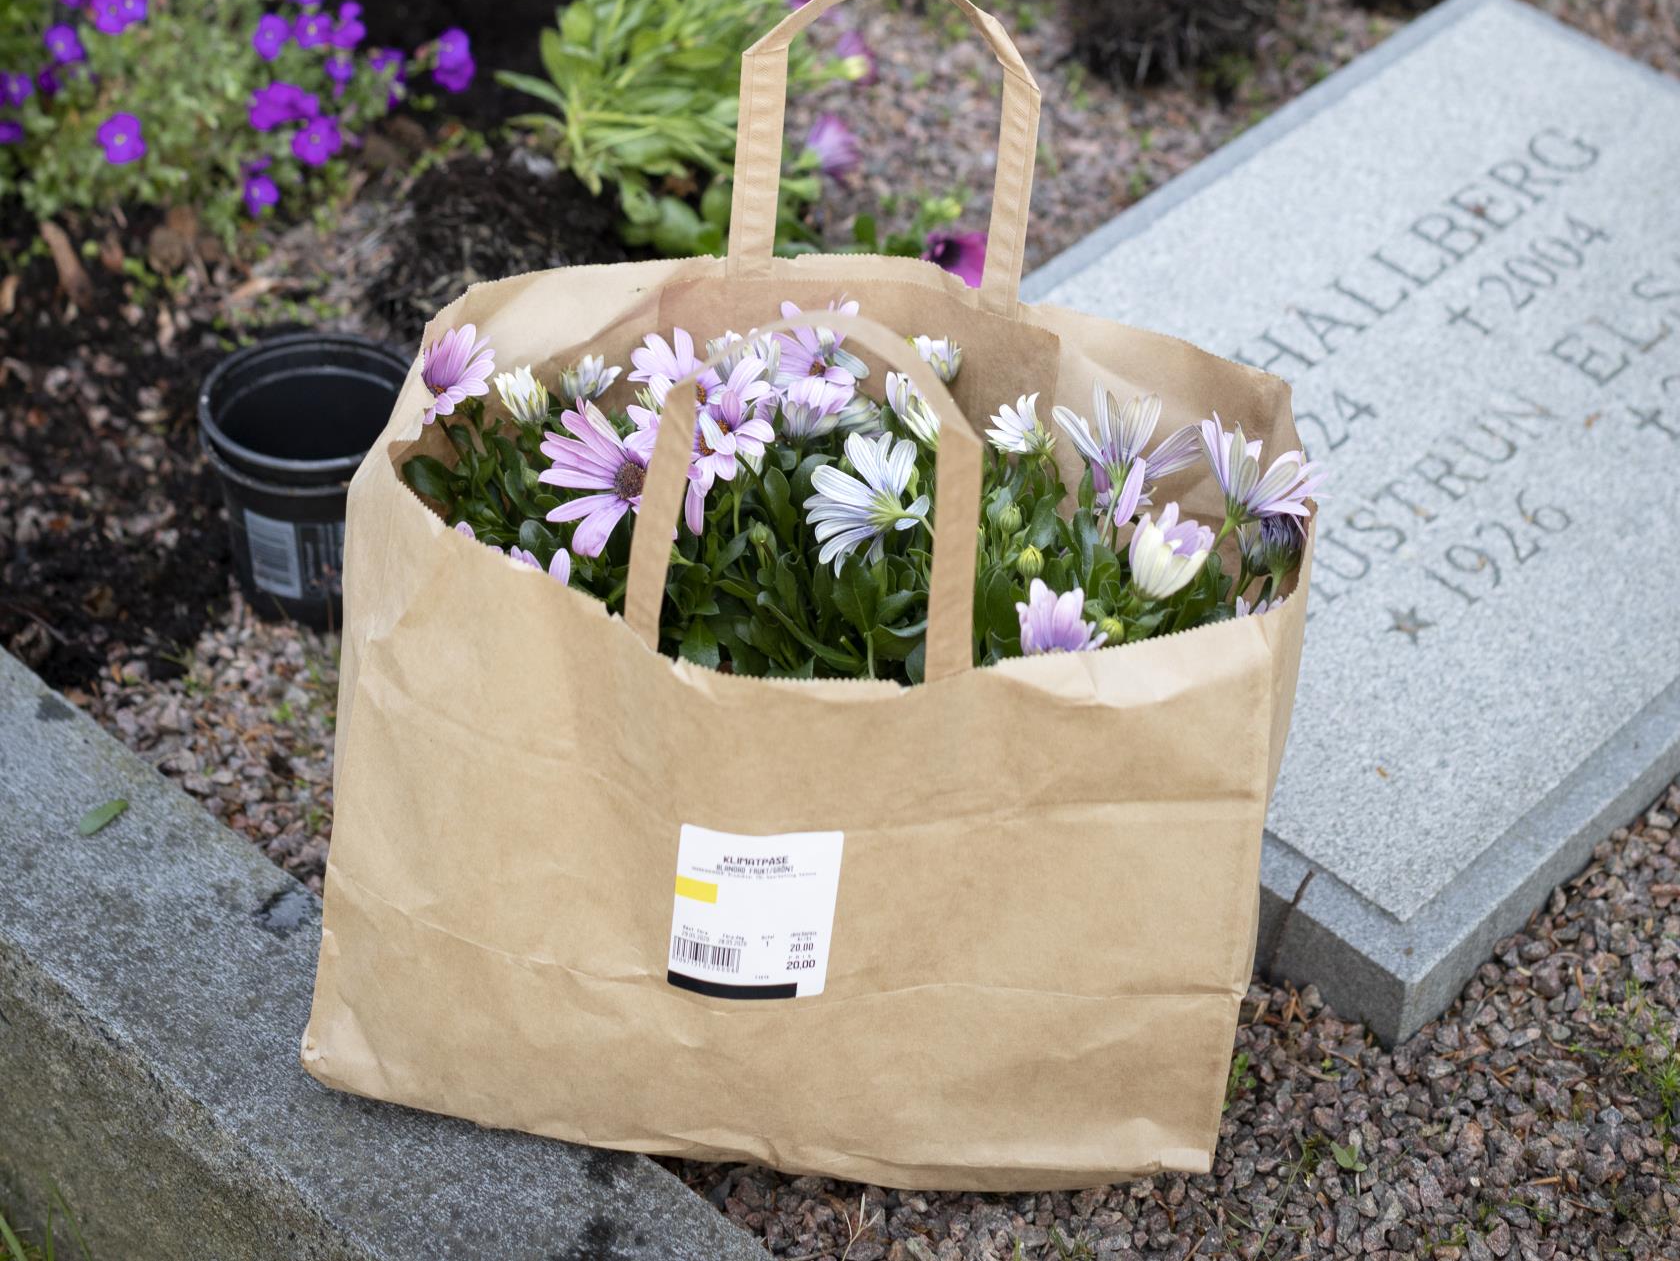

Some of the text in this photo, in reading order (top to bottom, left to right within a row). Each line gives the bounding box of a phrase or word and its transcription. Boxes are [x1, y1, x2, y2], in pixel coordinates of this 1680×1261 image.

[1240, 127, 1600, 375] HALLBERG
[1476, 212, 1610, 311] 2004
[1541, 254, 1680, 388] ELS
[1427, 488, 1572, 606] 1926
[786, 959, 816, 971] 20,00
